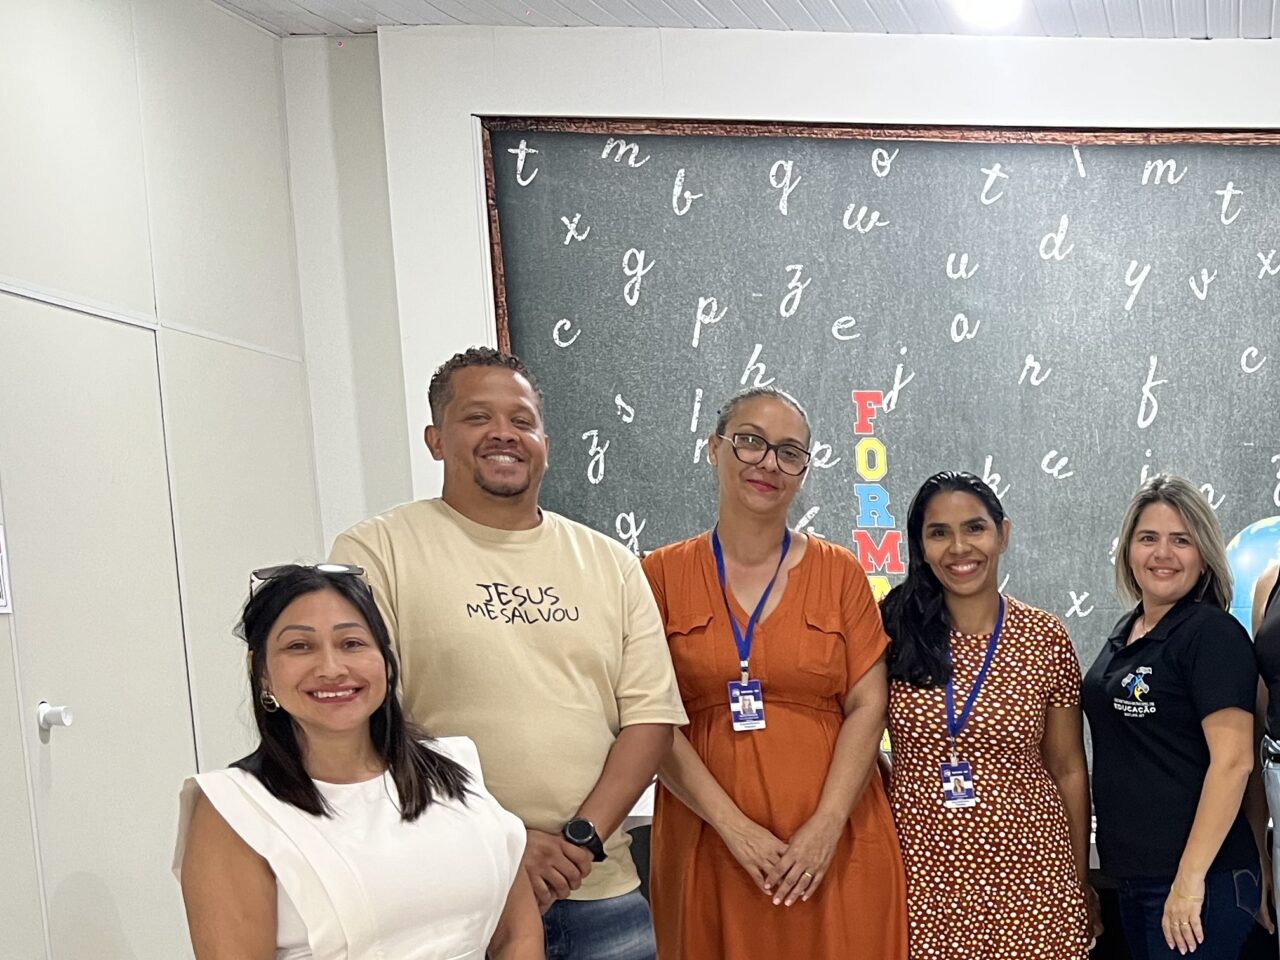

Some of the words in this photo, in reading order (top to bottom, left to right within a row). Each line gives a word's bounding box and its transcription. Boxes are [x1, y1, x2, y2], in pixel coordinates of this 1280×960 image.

[508, 140, 539, 186] t
[602, 137, 650, 168] m
[980, 163, 1009, 205] t
[1141, 158, 1188, 185] m
[1215, 181, 1244, 225] t
[560, 212, 591, 246] x
[1039, 214, 1074, 261] d
[622, 247, 656, 307] g
[552, 318, 581, 348] c
[691, 296, 729, 348] p
[831, 315, 861, 341] e
[1240, 346, 1267, 374] c
[476, 582, 560, 606] JESUS
[1065, 590, 1095, 619] x
[1113, 702, 1157, 713] EDUCAÇÃO
